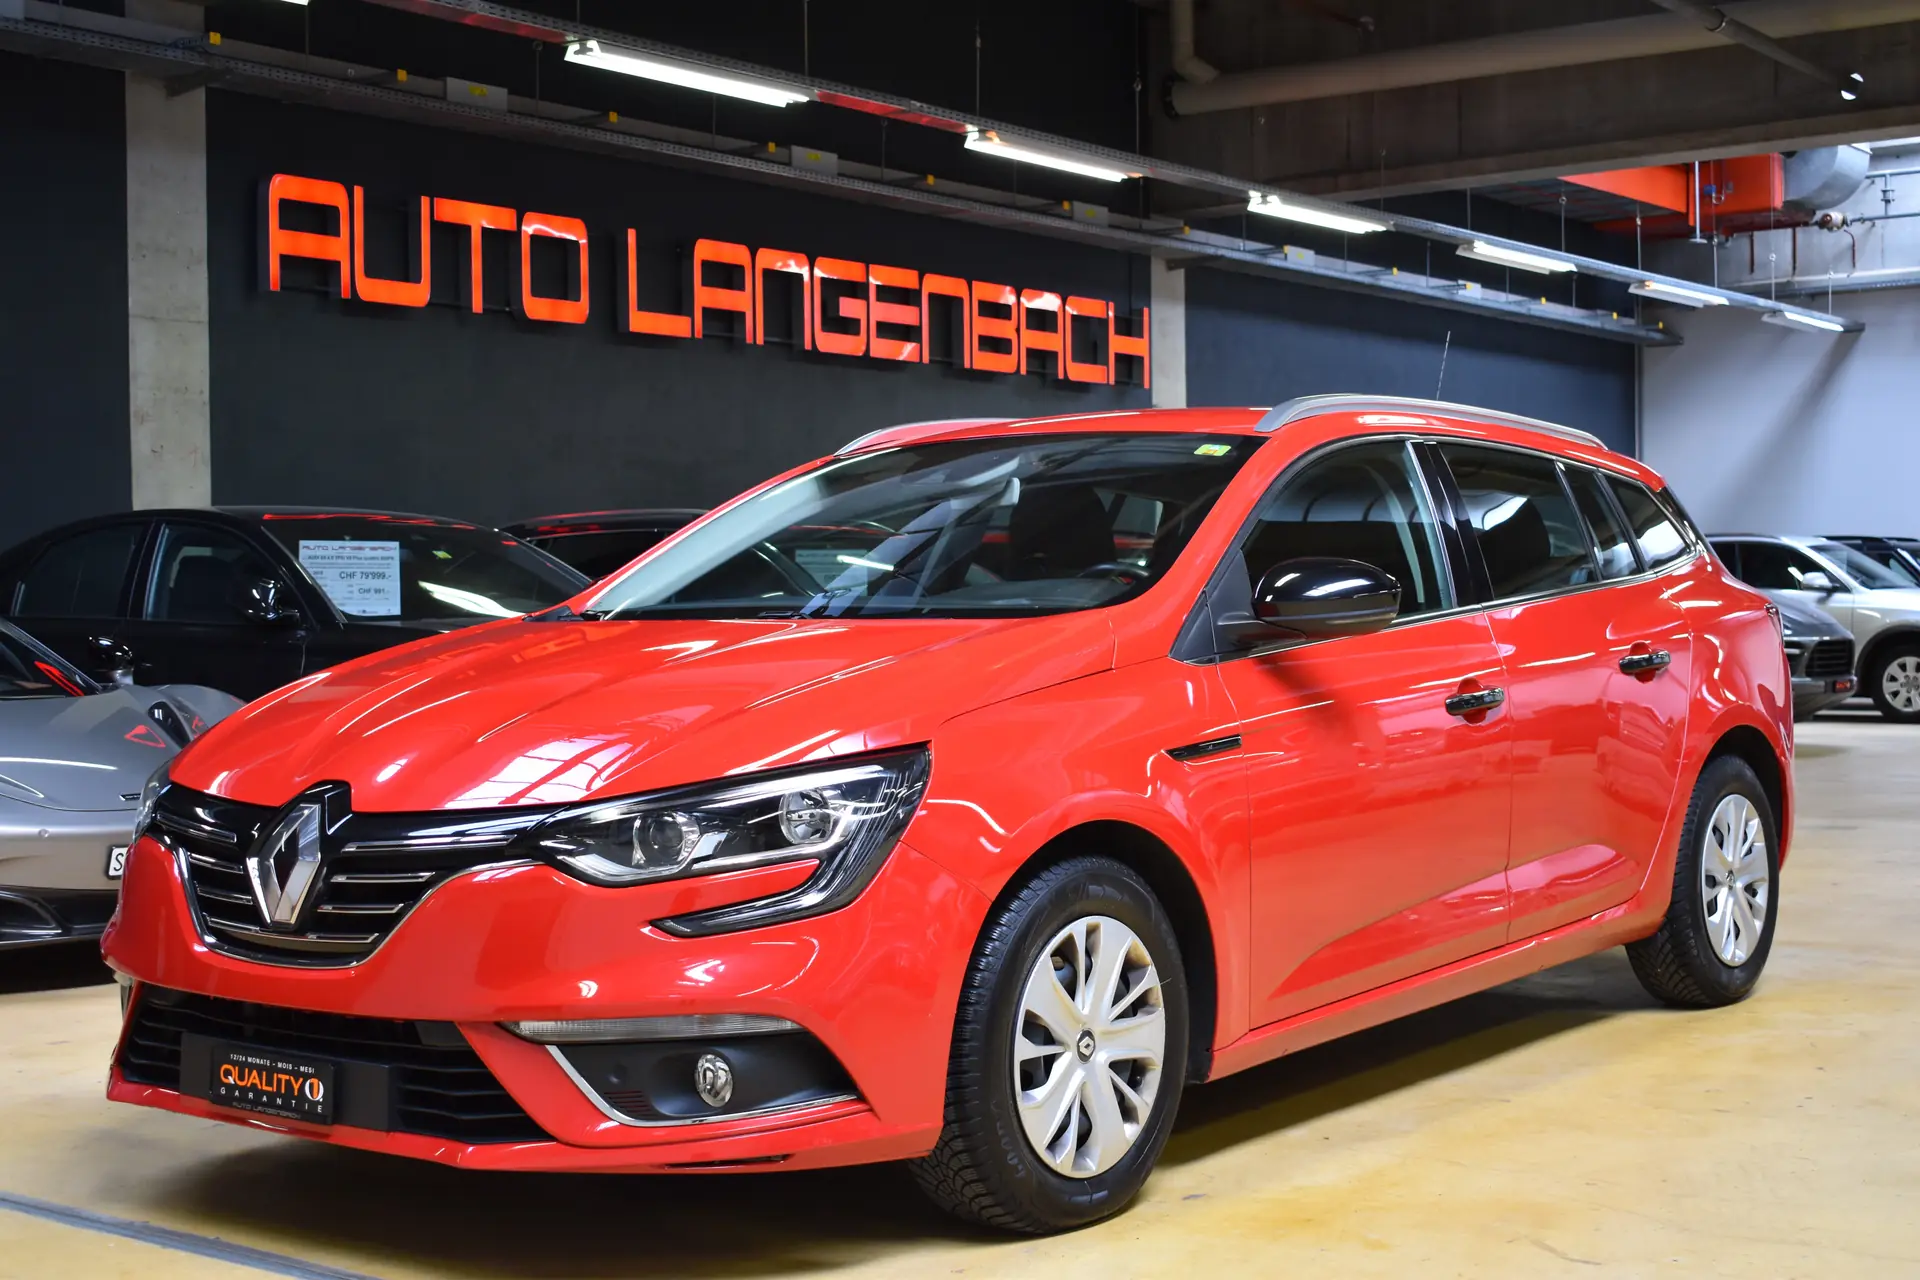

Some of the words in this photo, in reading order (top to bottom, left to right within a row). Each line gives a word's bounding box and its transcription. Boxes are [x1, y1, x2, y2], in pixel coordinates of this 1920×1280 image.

[268, 173, 590, 325] AUTO
[627, 227, 1151, 391] LANGENBACH
[339, 571, 357, 580] CHF
[360, 571, 392, 580] 79'999.-
[230, 1053, 246, 1061] 12/24
[247, 1056, 270, 1067] MONATE
[277, 1061, 293, 1070] MOIS
[300, 1065, 315, 1074] MESI
[220, 1064, 304, 1096] QUALITY
[220, 1086, 323, 1113] GARANTIE
[232, 1101, 252, 1110] AUTO
